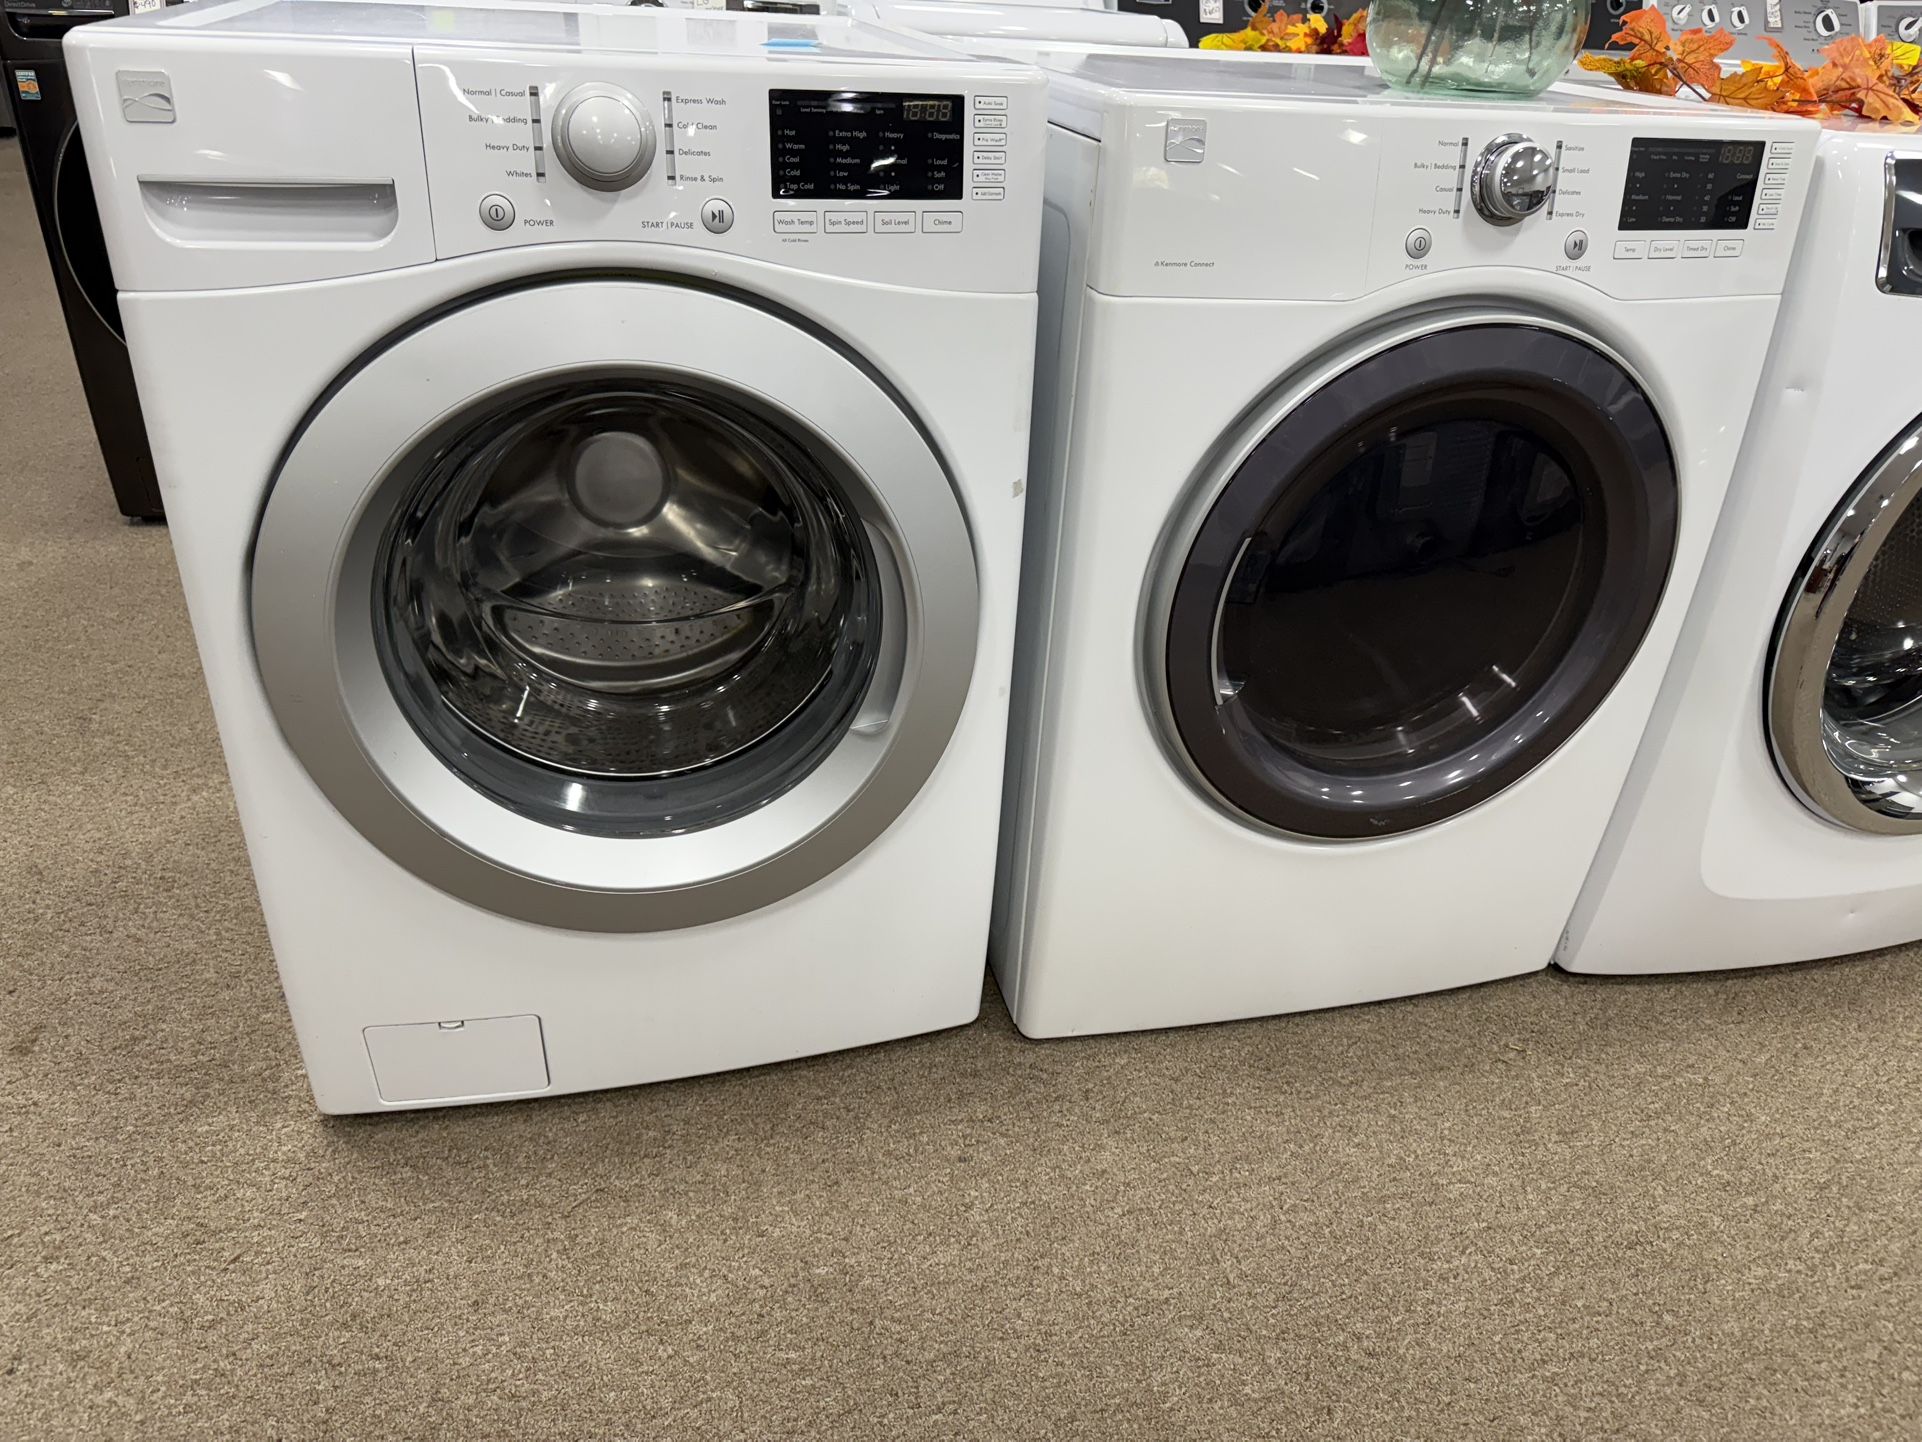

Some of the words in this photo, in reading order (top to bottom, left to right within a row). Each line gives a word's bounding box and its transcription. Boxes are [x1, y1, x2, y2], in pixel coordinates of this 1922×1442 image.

[463, 88, 492, 96] Normal
[500, 89, 526, 97] Casual
[676, 96, 703, 105] Express
[706, 97, 727, 106] Wash
[468, 114, 489, 124] Bulky
[696, 122, 718, 131] Clean
[852, 131, 867, 139] High
[885, 132, 904, 140] Heavy
[485, 143, 510, 152] Heavy
[512, 143, 530, 153] Duty
[835, 143, 850, 151] High
[1438, 140, 1459, 148] Normal
[678, 148, 711, 157] Delicates
[1414, 162, 1429, 170] Bulky
[1434, 163, 1457, 171] Bedding
[505, 170, 533, 178] Whites
[680, 174, 698, 182] Rinse
[700, 174, 706, 183] &
[708, 175, 724, 183] Spin
[847, 184, 861, 192] Spin
[885, 184, 900, 192] Light
[1435, 185, 1454, 193] Casual
[1558, 188, 1582, 196] Delicates
[1438, 208, 1451, 216] Duty
[1555, 210, 1574, 218] Express
[1575, 210, 1586, 219] Dry
[524, 219, 555, 227] POWER
[641, 220, 664, 229] START
[670, 221, 694, 230] PAUSE
[777, 218, 796, 226] Wash
[796, 218, 815, 228] Temp
[828, 218, 843, 228] Spin
[845, 218, 864, 228] Speed
[881, 218, 893, 226] Soil
[893, 218, 910, 226] Level
[933, 218, 953, 226] Chime
[1160, 260, 1188, 268] Kenmore
[1189, 260, 1215, 268] Connect
[1405, 263, 1428, 271] POWER
[1555, 265, 1572, 273] START
[1574, 265, 1592, 273] PAUSE
